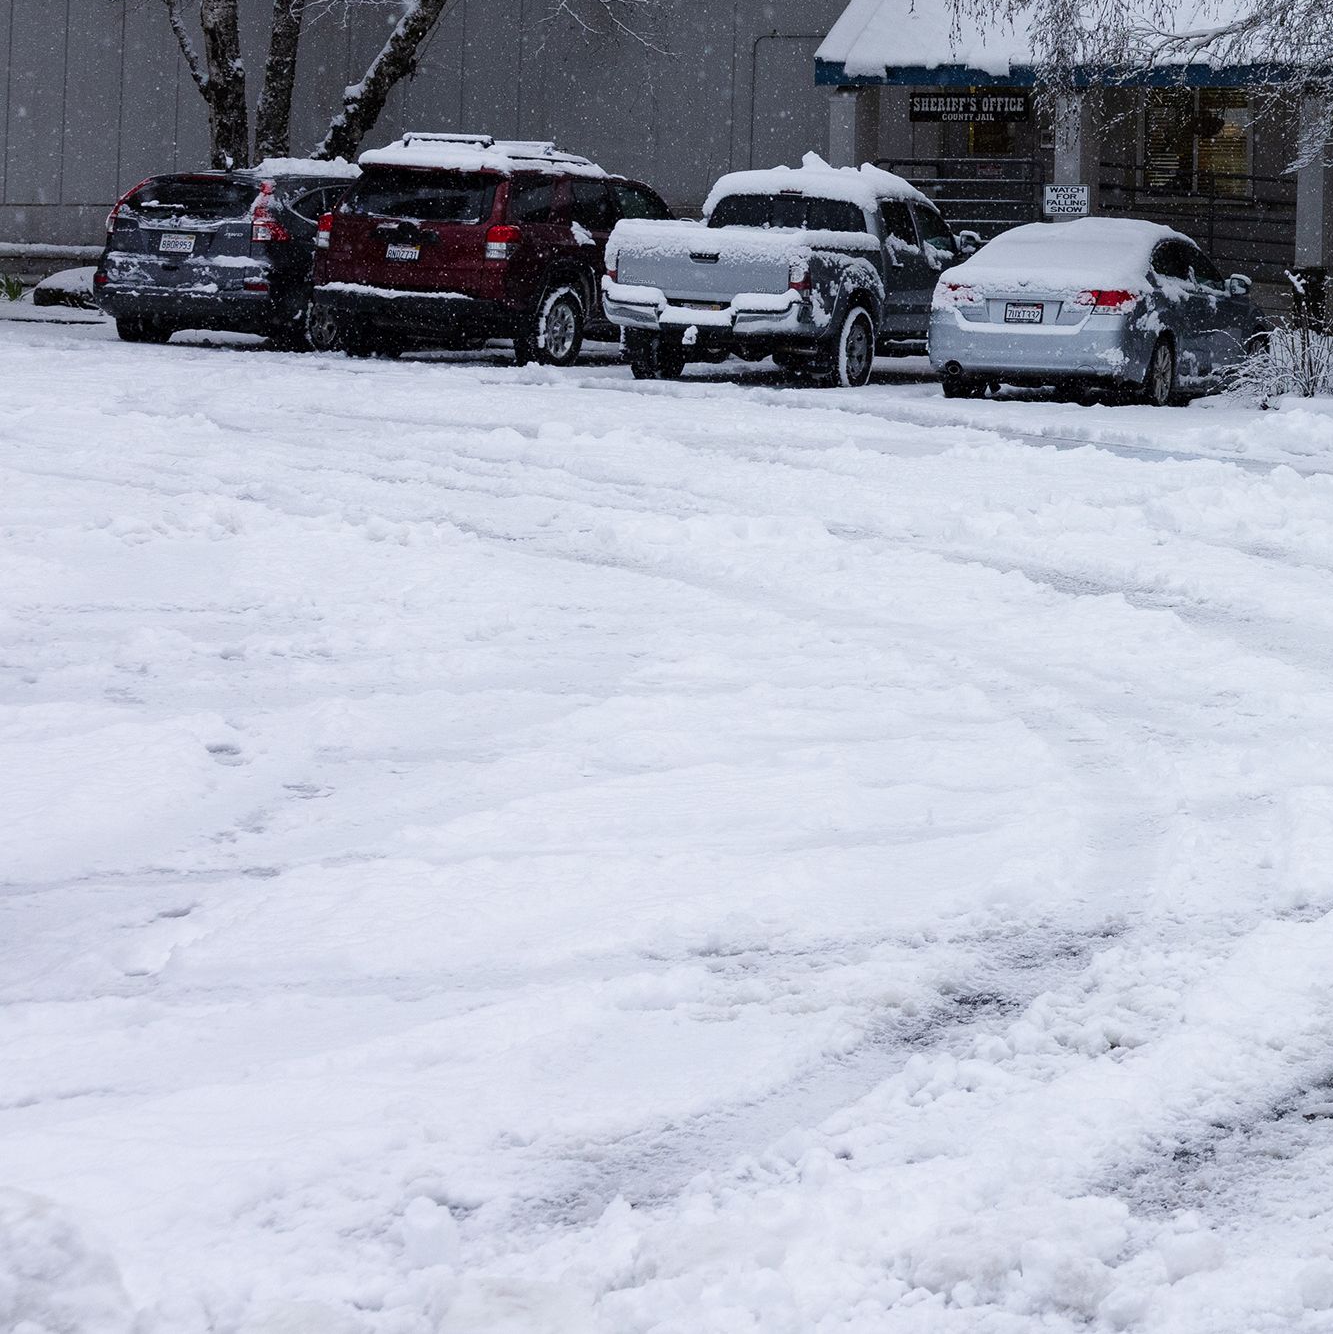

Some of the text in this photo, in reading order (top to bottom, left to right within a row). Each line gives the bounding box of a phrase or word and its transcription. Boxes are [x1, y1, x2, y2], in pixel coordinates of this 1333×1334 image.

[913, 97, 1024, 112] SHERIFF'S OFFICE
[942, 113, 994, 121] COUNTY JAIL
